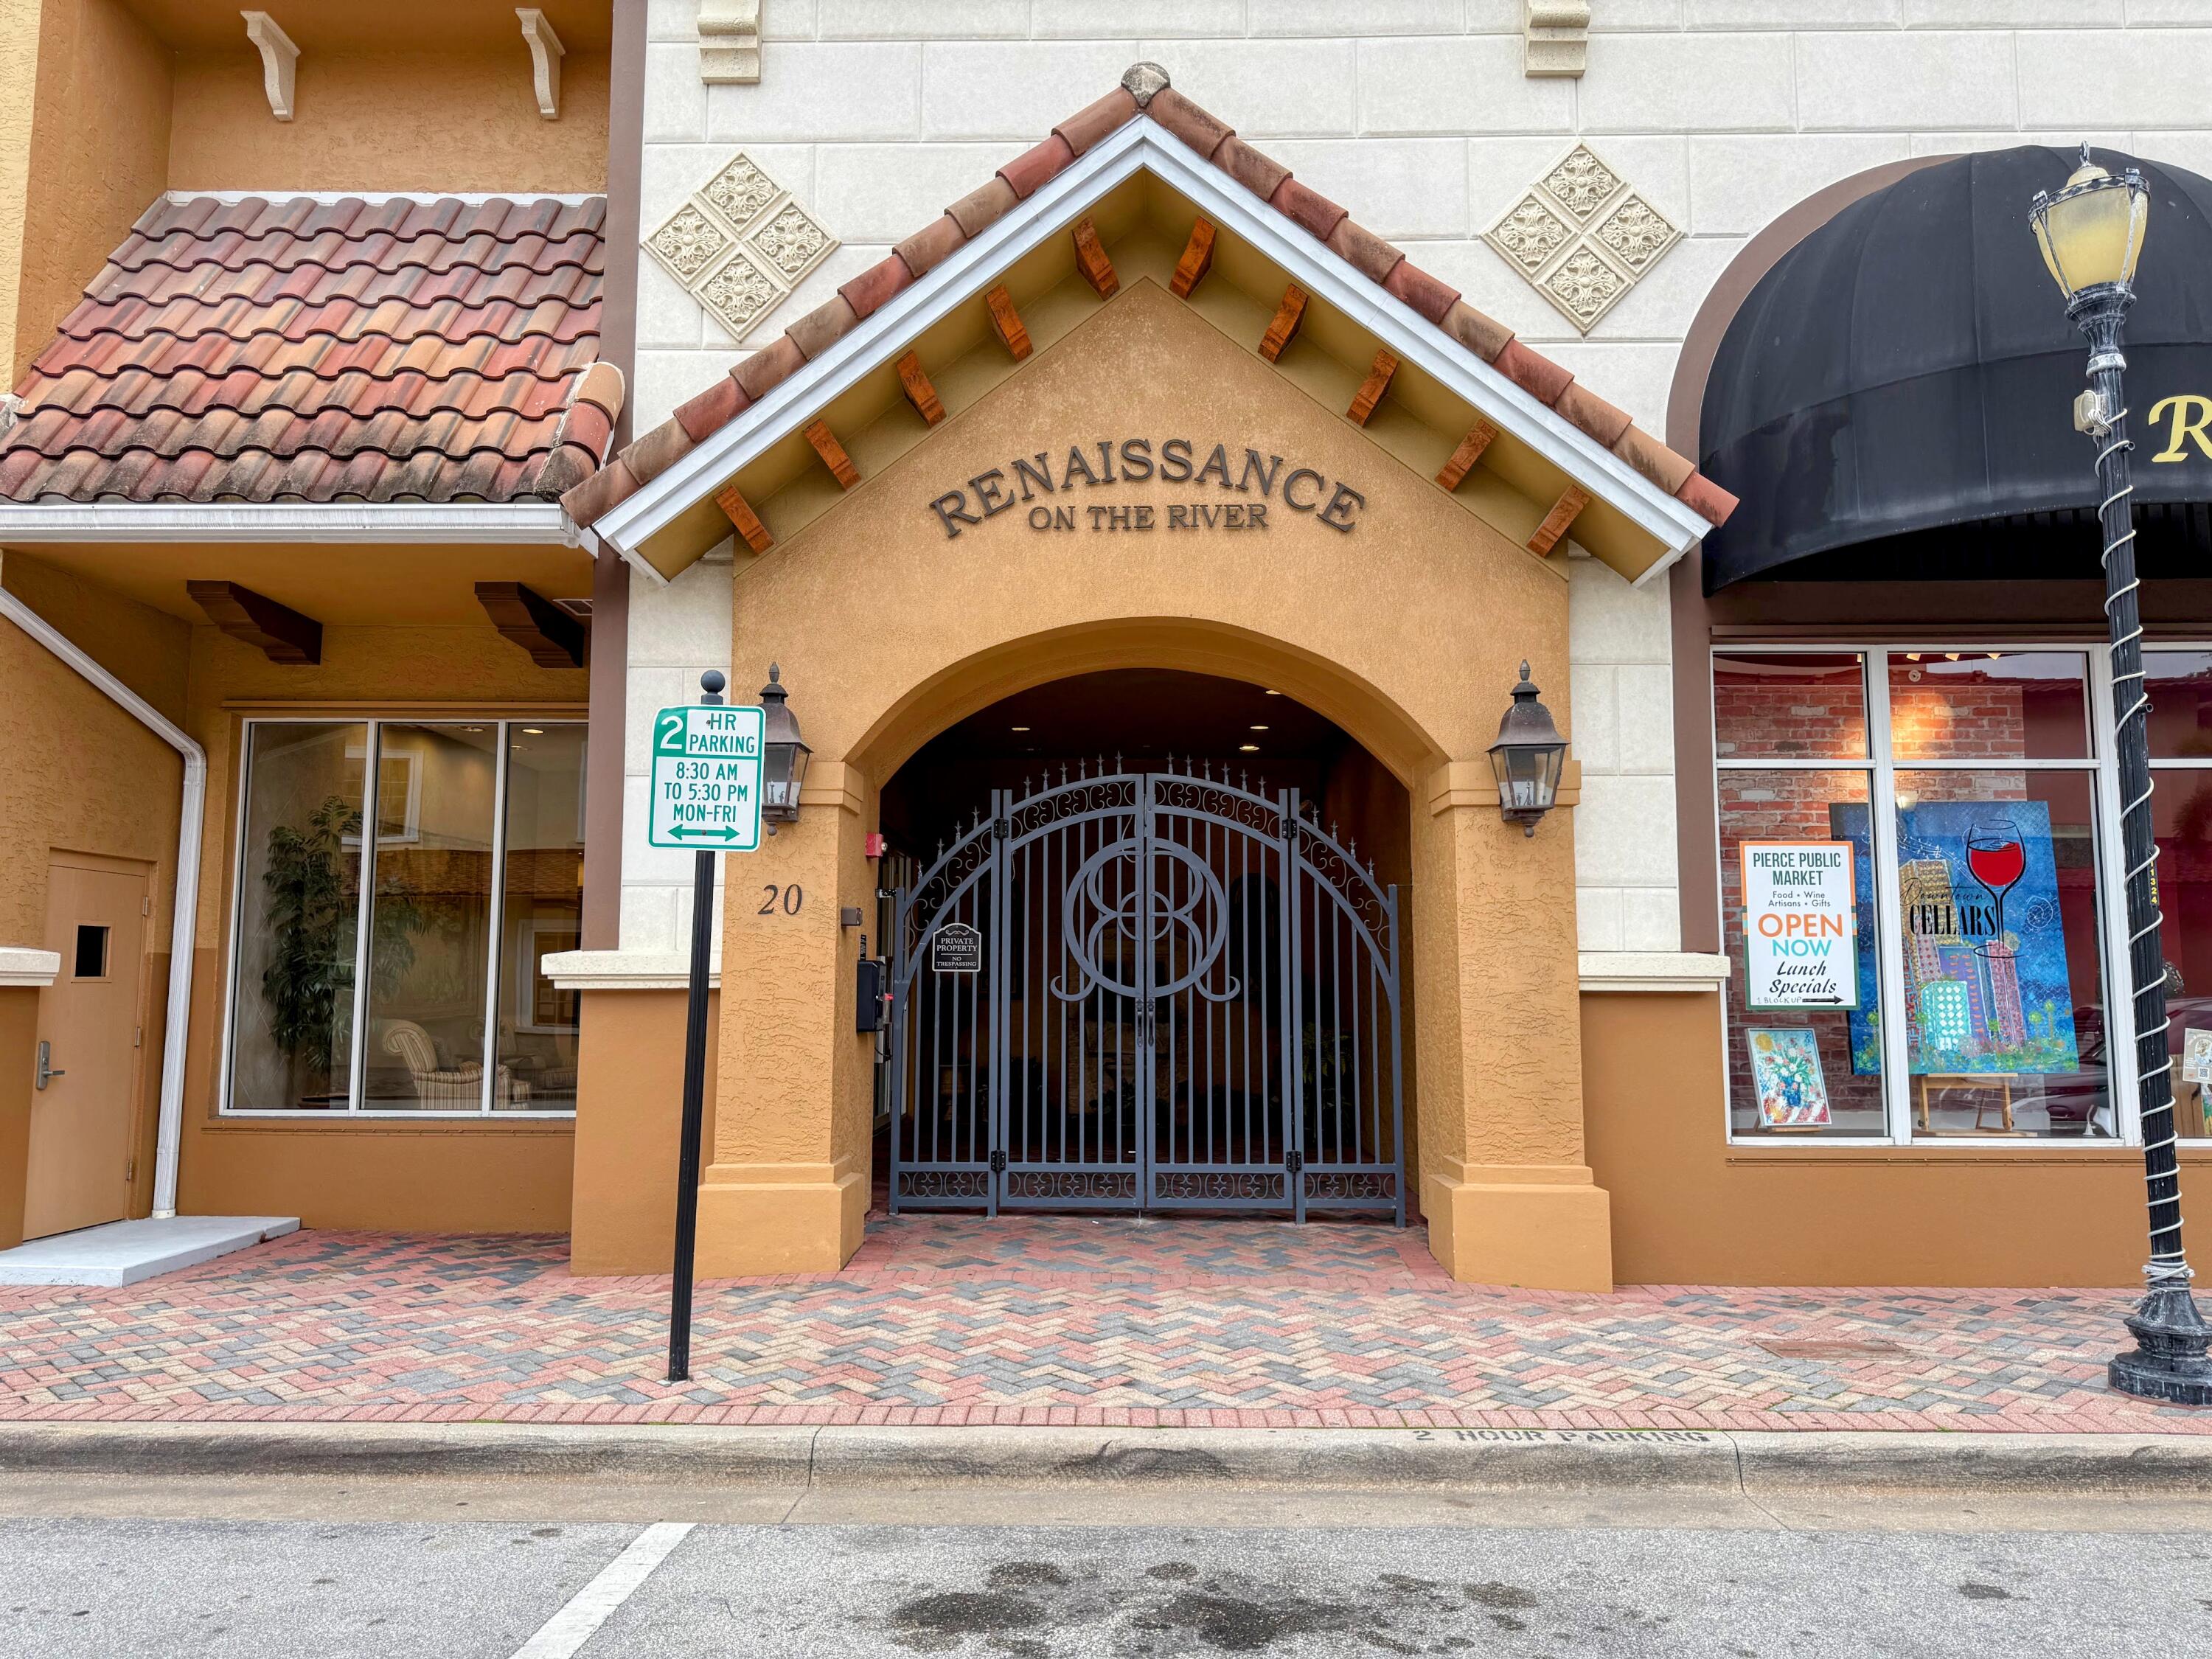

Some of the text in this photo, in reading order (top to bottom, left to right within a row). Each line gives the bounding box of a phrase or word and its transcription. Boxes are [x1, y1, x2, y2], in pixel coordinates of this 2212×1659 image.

[928, 439, 1366, 539] RENAISSANCE
[1028, 503, 1269, 530] ON THE RIVER
[660, 713, 737, 749] 2 HR
[689, 734, 755, 754] PARKING
[676, 762, 738, 781] 8:30 AM
[664, 782, 748, 801] TO 5:30 PM
[673, 804, 737, 822] MON-FRI
[1753, 852, 1841, 868] PIERCE PUBLIC
[1773, 870, 1823, 886] MARKET
[757, 884, 802, 915] 20
[1773, 891, 1826, 899] Food Wine
[1900, 877, 1986, 906] Downtown
[1758, 913, 1843, 938] OPEN
[1910, 905, 1996, 936] CELLARS
[1773, 939, 1832, 957] NOW
[1776, 960, 1826, 976] Lunch
[1769, 978, 1837, 998] Specials
[1415, 1430, 1712, 1442] 2 HOUR PARKING
